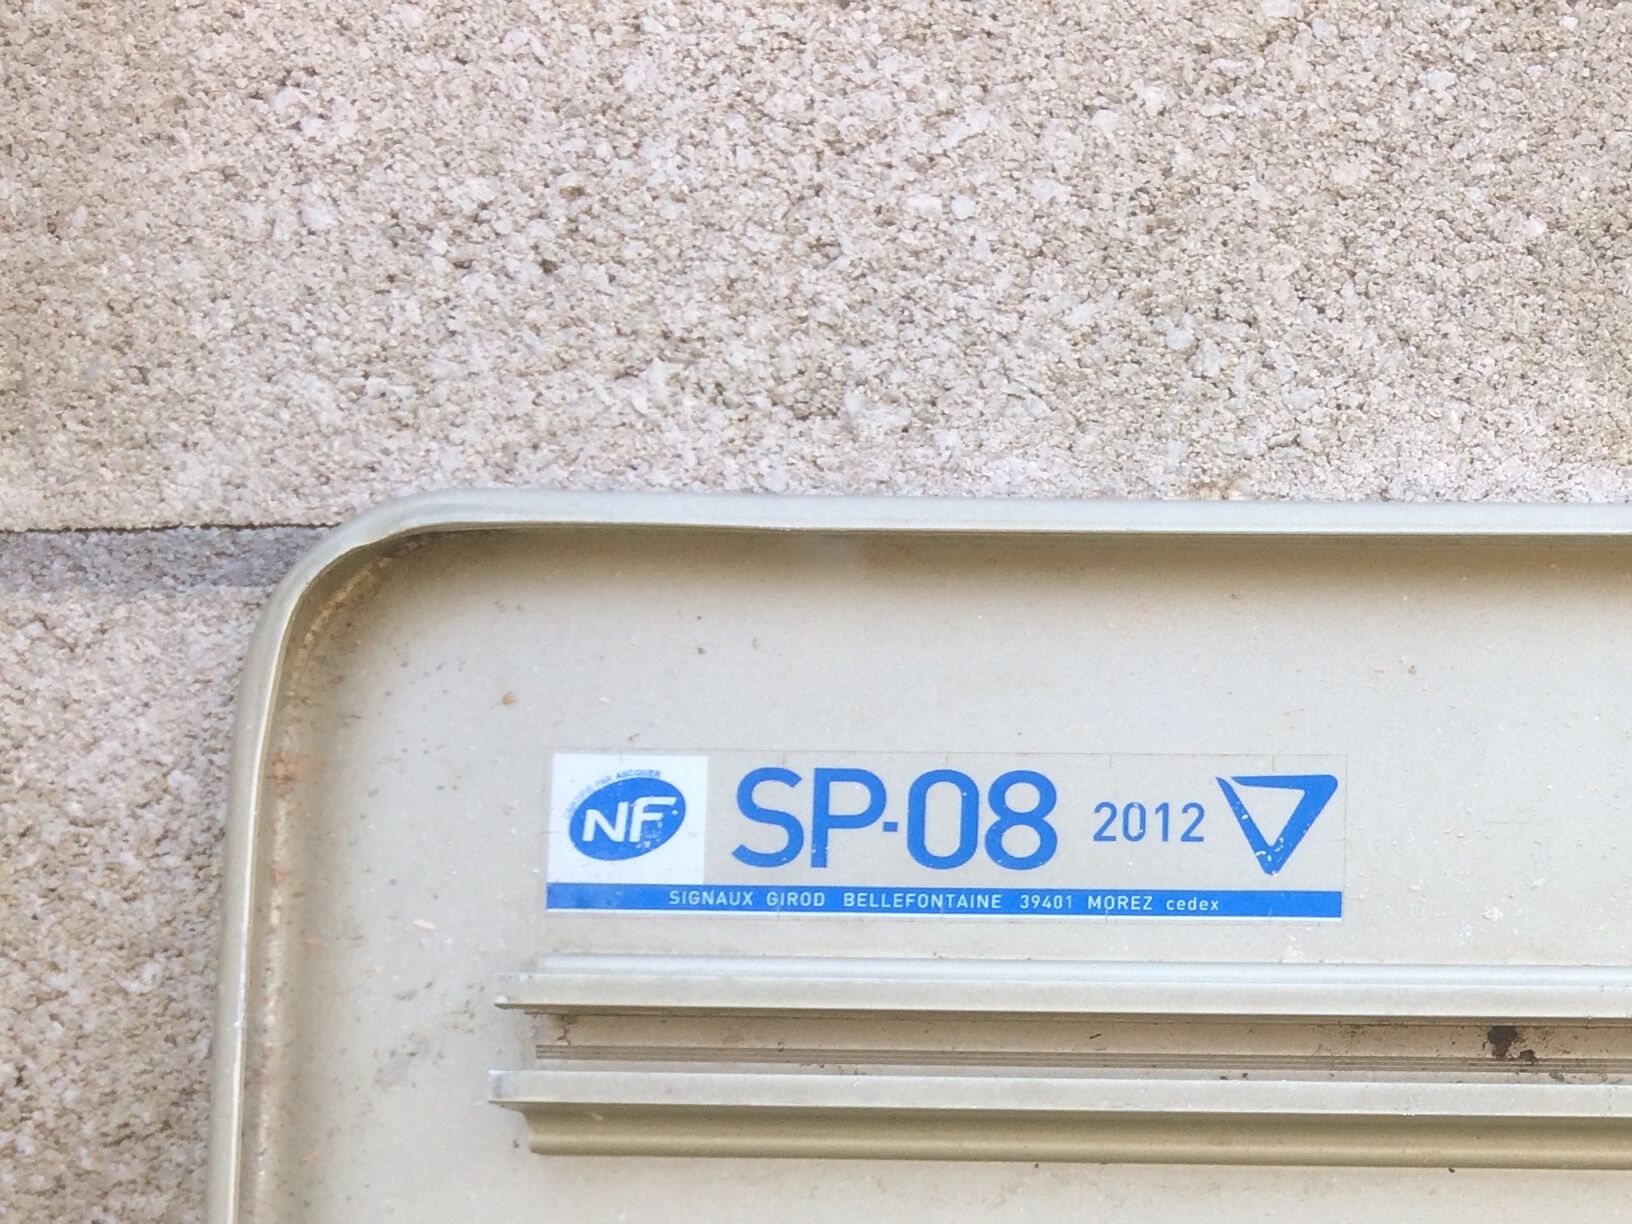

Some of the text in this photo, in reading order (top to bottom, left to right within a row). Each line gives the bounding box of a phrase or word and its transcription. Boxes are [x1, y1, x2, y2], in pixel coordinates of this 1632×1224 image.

[582, 797, 676, 842] NF
[732, 767, 1205, 870] SP-08 2012
[668, 890, 1220, 911] SIGNAUX GIROD BELLEFONTAINE 39401 MOREZ cedex
